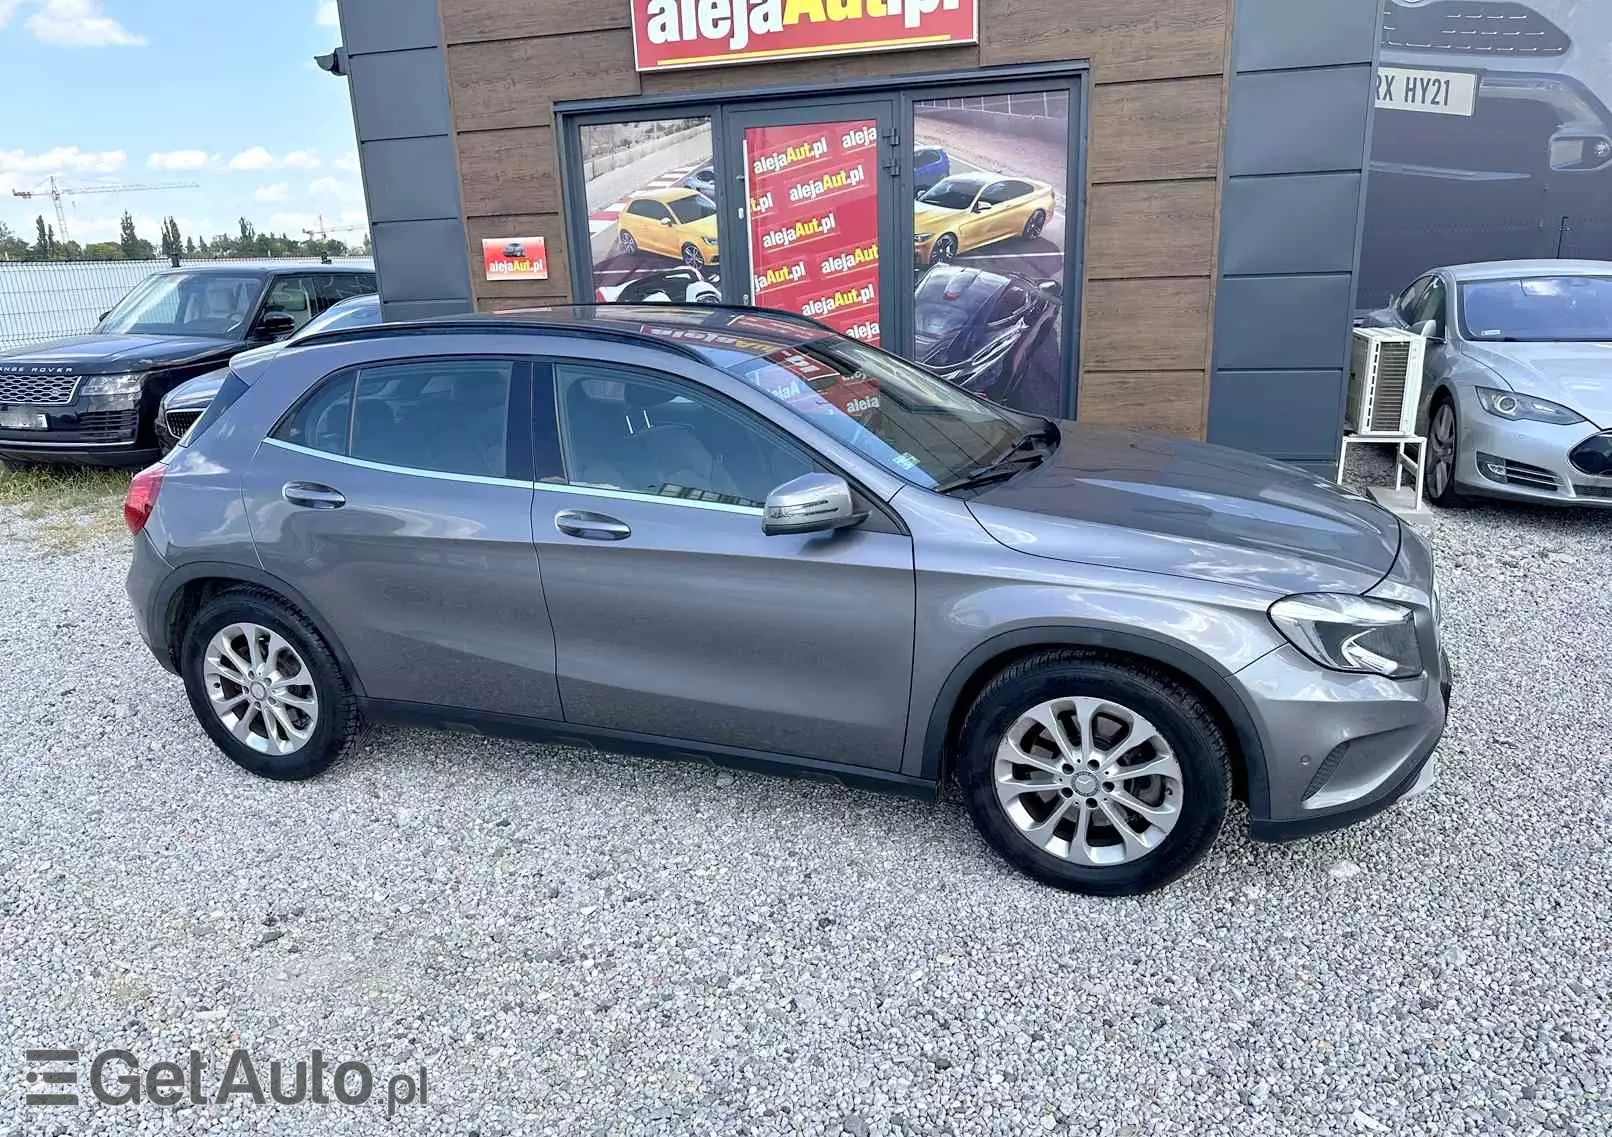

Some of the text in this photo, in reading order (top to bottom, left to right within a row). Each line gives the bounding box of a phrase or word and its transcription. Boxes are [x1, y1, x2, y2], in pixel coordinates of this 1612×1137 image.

[648, 0, 959, 49] alejaAu.p
[1404, 76, 1450, 106] HY21
[842, 126, 877, 149] aleja
[753, 136, 828, 174] alejaAut.pl
[789, 164, 865, 202] alejaAut.pl
[762, 212, 836, 248] alejaAut.pl
[488, 258, 544, 273] alejaAut.pl
[821, 243, 879, 275] alejaAut
[801, 283, 875, 316] alejaAut.pl
